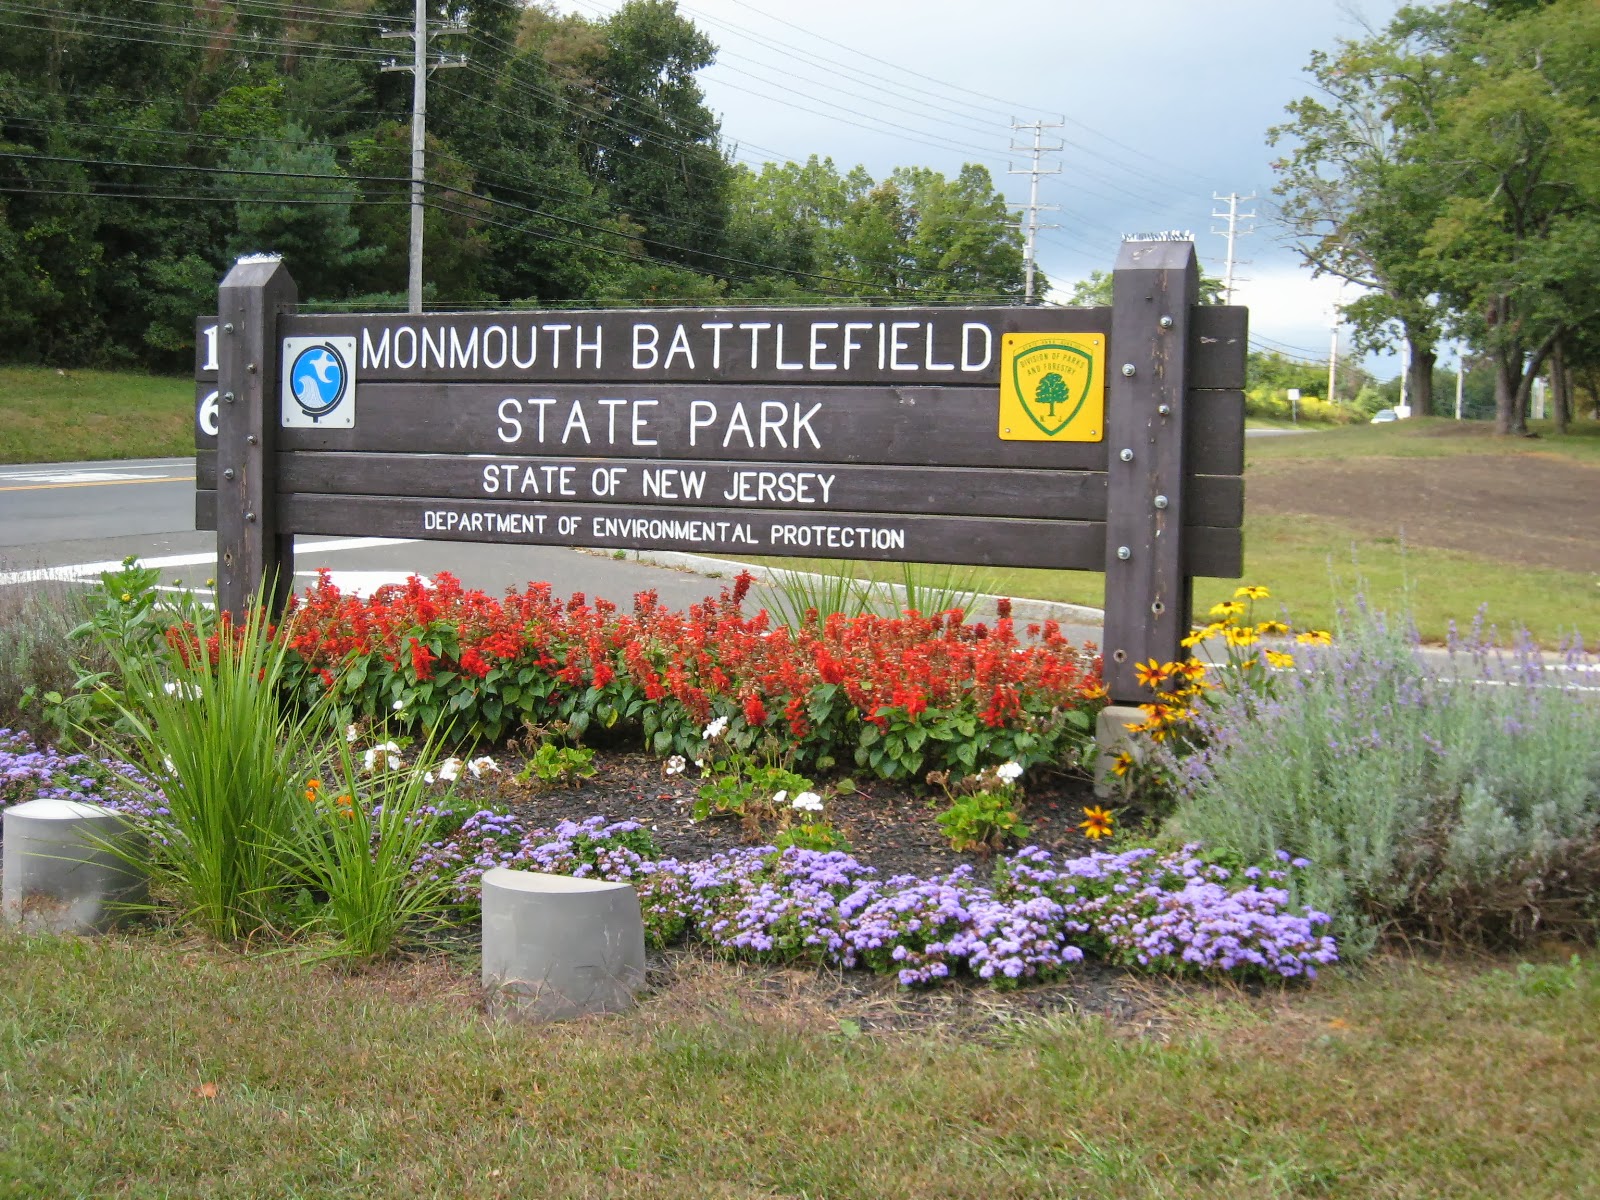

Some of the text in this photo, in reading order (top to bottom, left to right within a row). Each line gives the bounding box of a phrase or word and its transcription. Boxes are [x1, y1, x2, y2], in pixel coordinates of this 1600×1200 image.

[362, 322, 993, 372] MONMOUTH BATTLEFIELD
[1019, 352, 1086, 369] DIVISION OF PARKS
[1026, 362, 1077, 376] AND FORESTRY
[497, 397, 823, 450] STATE PARK
[482, 464, 836, 504] STATE OF NEW JERSEY
[424, 510, 905, 550] DEPARTMENT OF ENVIRONMENTAL PROTECTION
